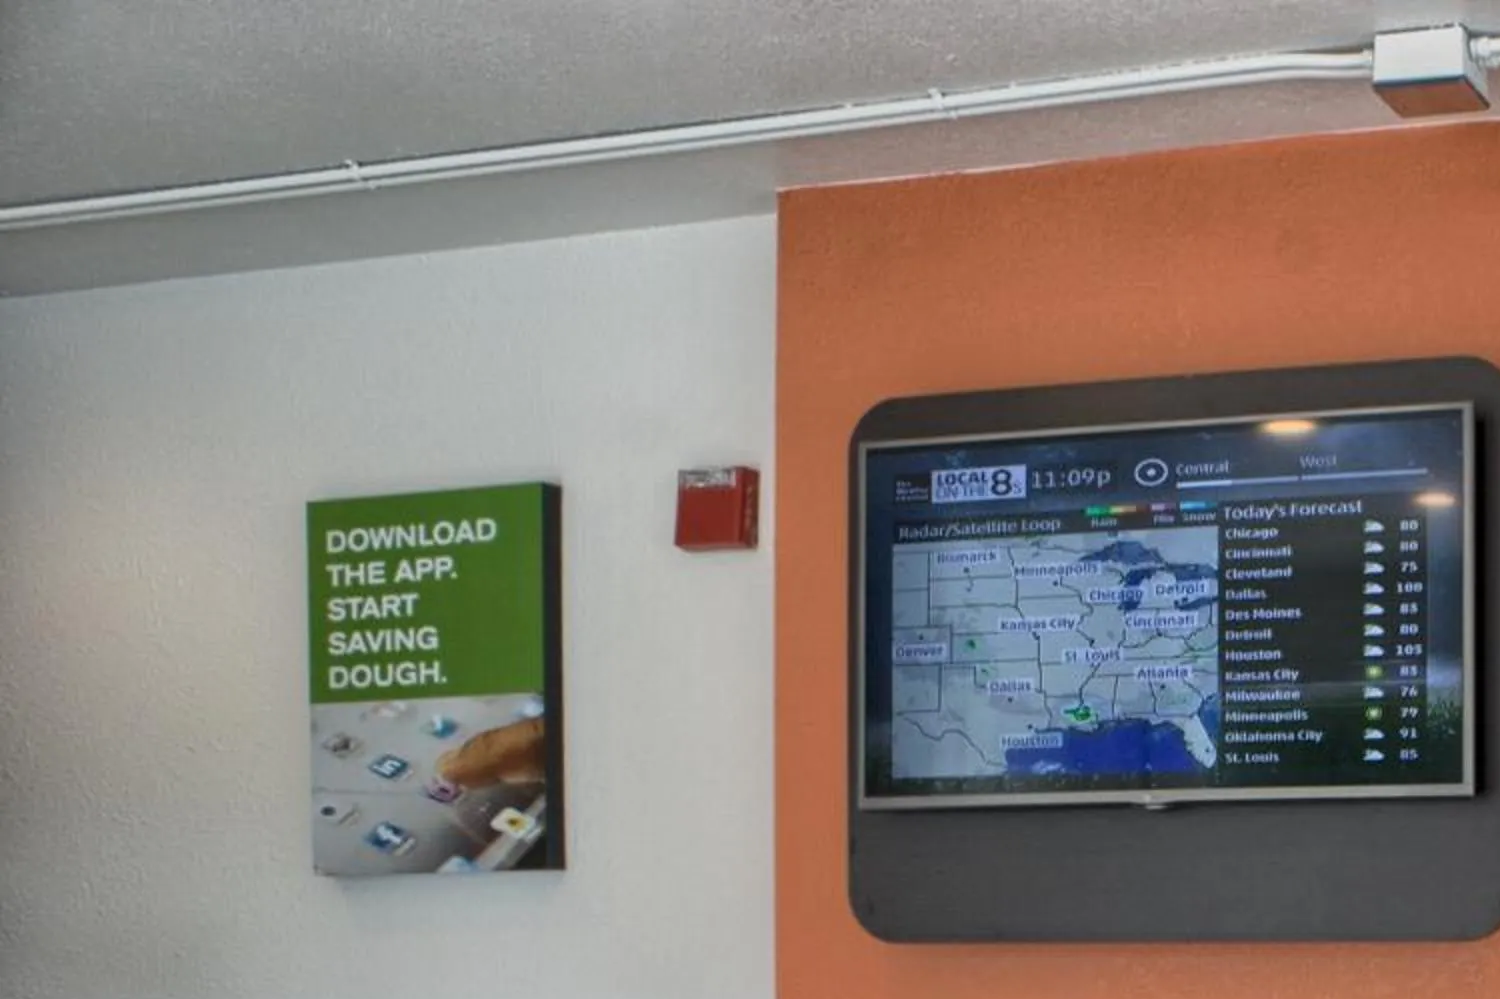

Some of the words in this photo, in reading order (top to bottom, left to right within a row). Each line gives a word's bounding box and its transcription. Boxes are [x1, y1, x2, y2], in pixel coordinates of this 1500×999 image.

[1176, 460, 1230, 475] Central
[936, 471, 988, 486] LOCAL
[1031, 467, 1112, 489] 11:09p
[1224, 504, 1287, 521] Today's
[1290, 500, 1363, 517] Forecast
[325, 516, 497, 555] DOWNLOAD
[899, 520, 1017, 540] Radar/Satellite
[1021, 517, 1061, 534] Loop
[1225, 527, 1279, 541] Chicago
[325, 561, 386, 588] THE
[393, 556, 459, 584] APP.
[1225, 565, 1293, 581] Cleveland
[1088, 588, 1144, 602] Chicago
[1155, 582, 1206, 596] Detroit
[1225, 588, 1268, 601] Dallas
[326, 592, 420, 623] START
[1225, 609, 1249, 621] Des
[1252, 606, 1302, 620] Moines
[1001, 619, 1047, 632] Kansas
[1050, 616, 1077, 631] City
[1125, 614, 1195, 628] Cincinnati
[327, 625, 440, 657] SAVING
[896, 643, 946, 658] Denver
[1085, 648, 1121, 661] Louis
[1225, 649, 1282, 661] Houston
[328, 660, 448, 690] DOUGH.
[1137, 666, 1190, 679] Atlanta
[1225, 670, 1271, 682] Kansas
[1273, 668, 1300, 682] City
[989, 681, 1032, 693] Dallas
[1225, 689, 1301, 702] Milwaukee
[1225, 708, 1309, 724] Minneapolis
[1002, 733, 1062, 748] Houston
[1225, 730, 1295, 744] Oklahoma
[1297, 728, 1324, 744] City
[1245, 751, 1281, 764] Louis
